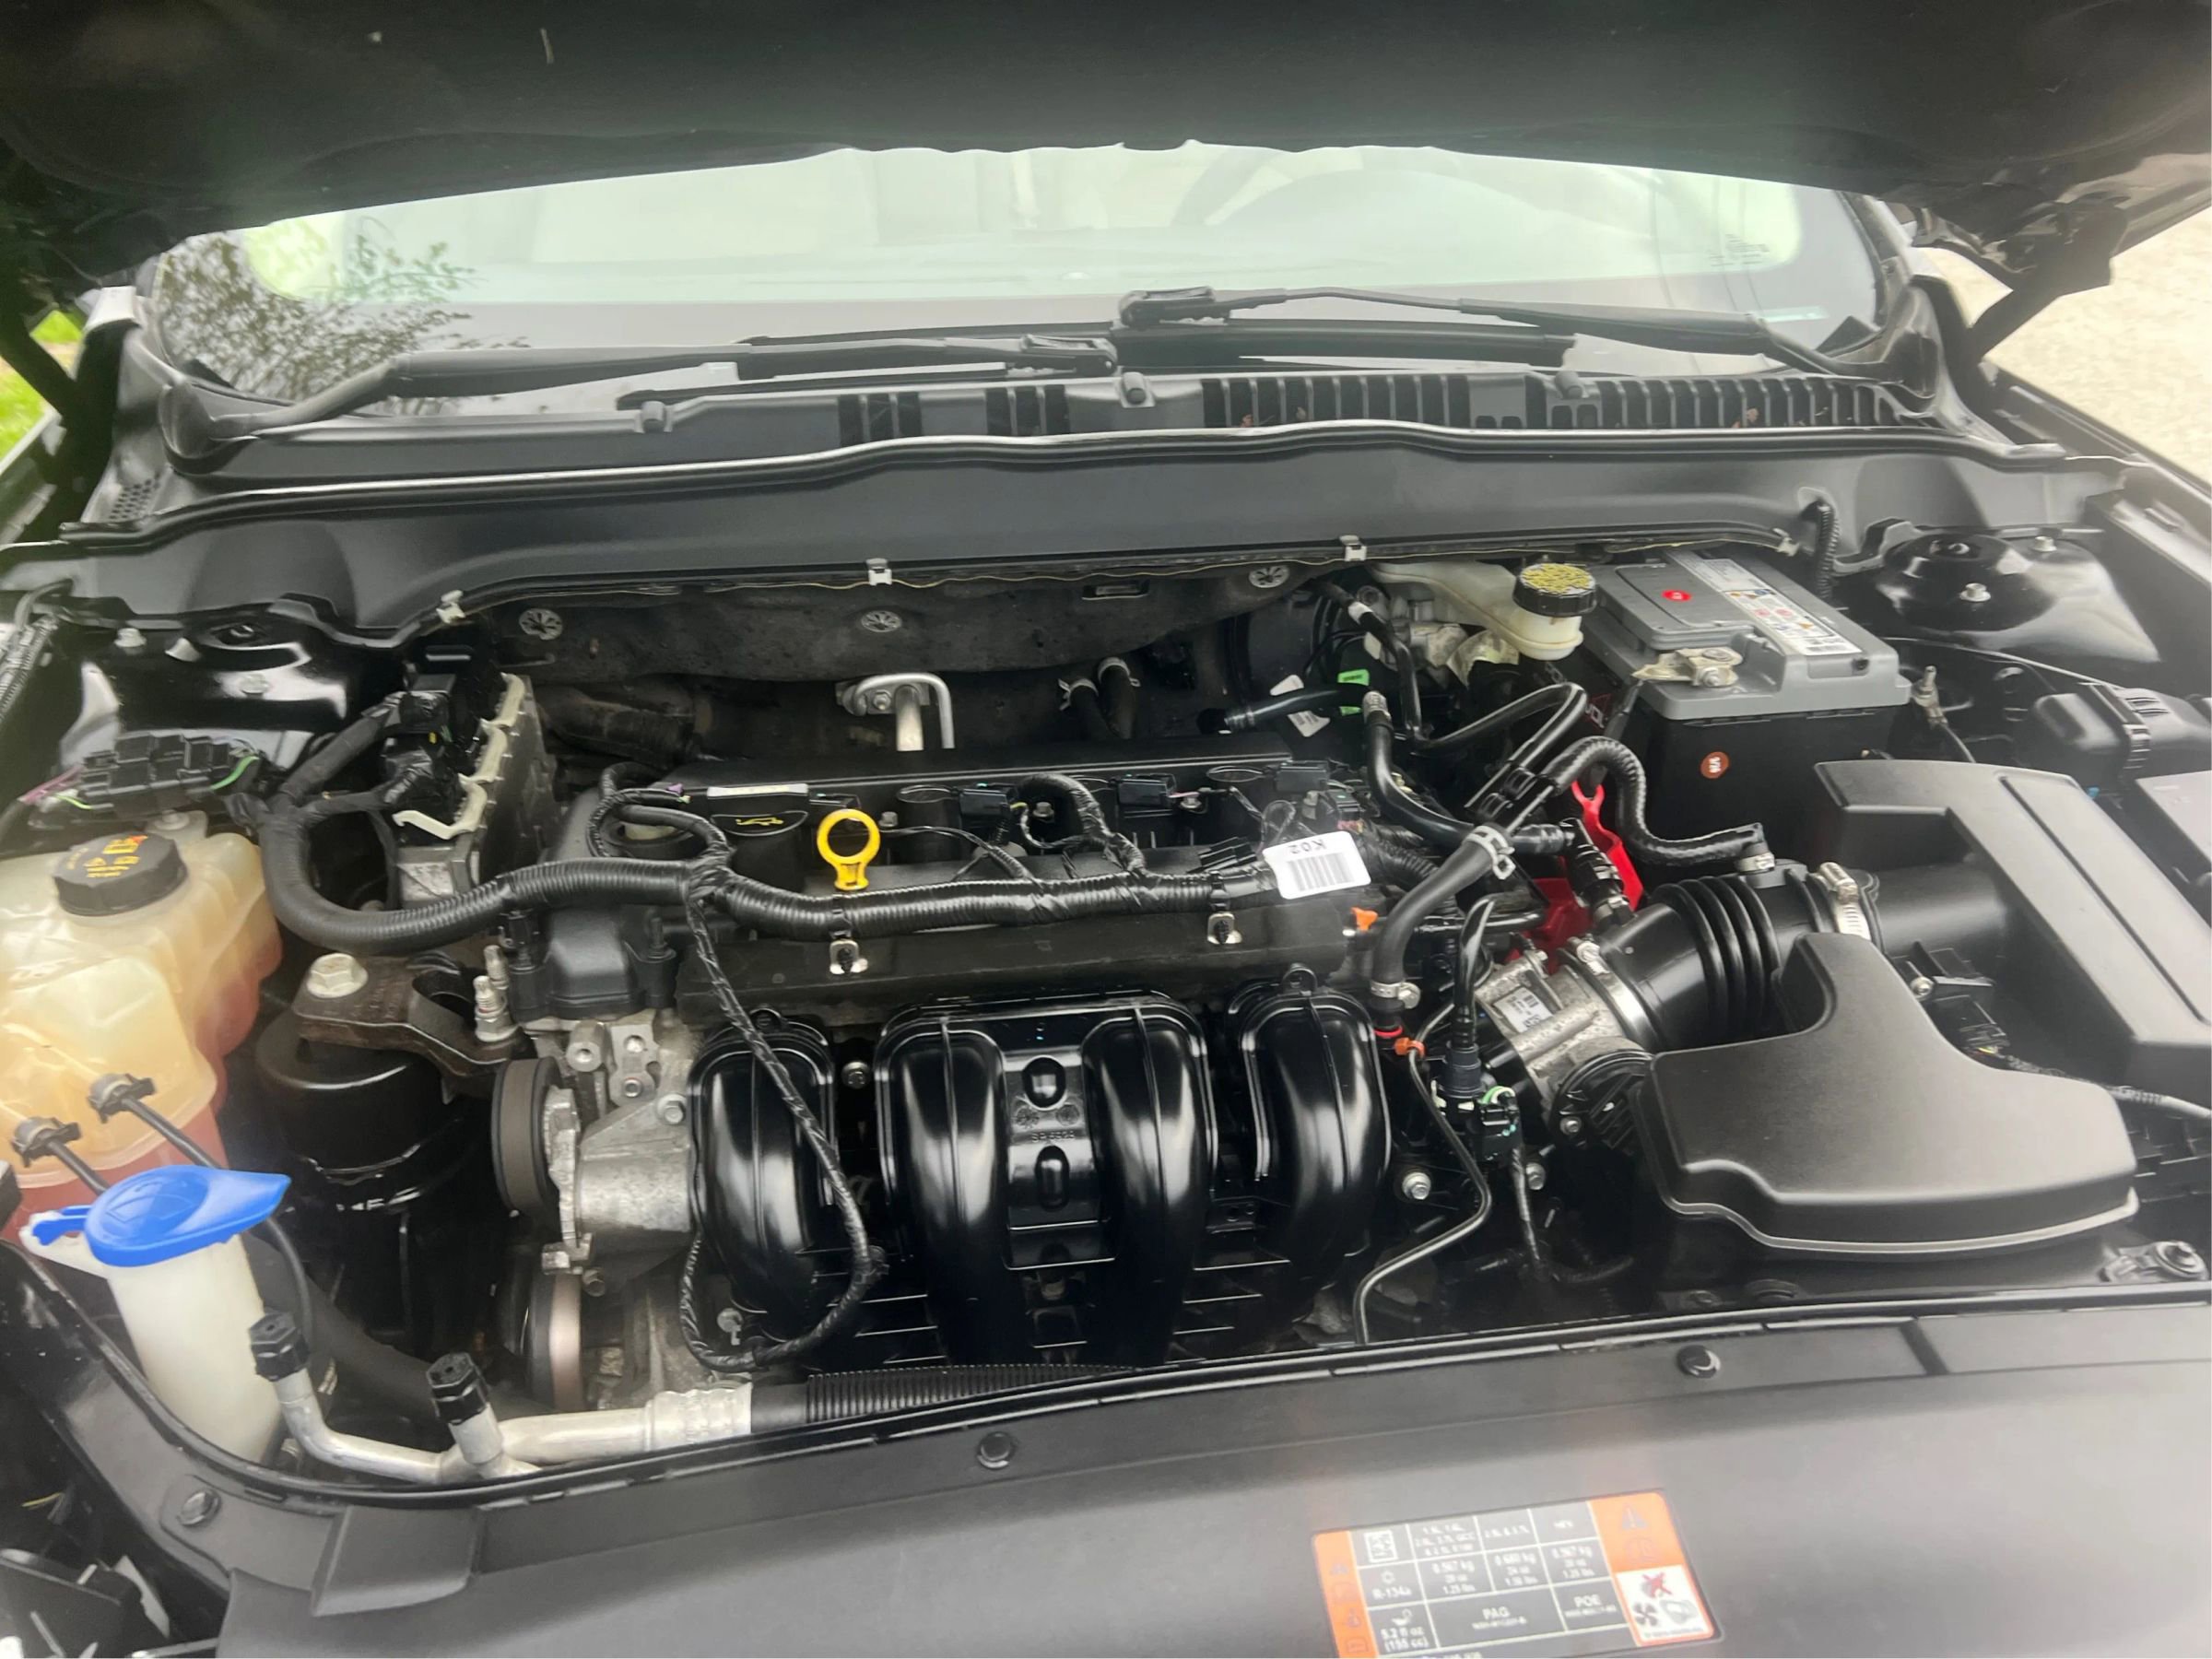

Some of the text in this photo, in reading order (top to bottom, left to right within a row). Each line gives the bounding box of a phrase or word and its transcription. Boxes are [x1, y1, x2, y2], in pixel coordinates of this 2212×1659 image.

[1288, 839, 1326, 853] K02
[1371, 1584, 1412, 1600] R-134a
[1573, 1594, 1602, 1607] POE
[1482, 1606, 1510, 1620] PAG
